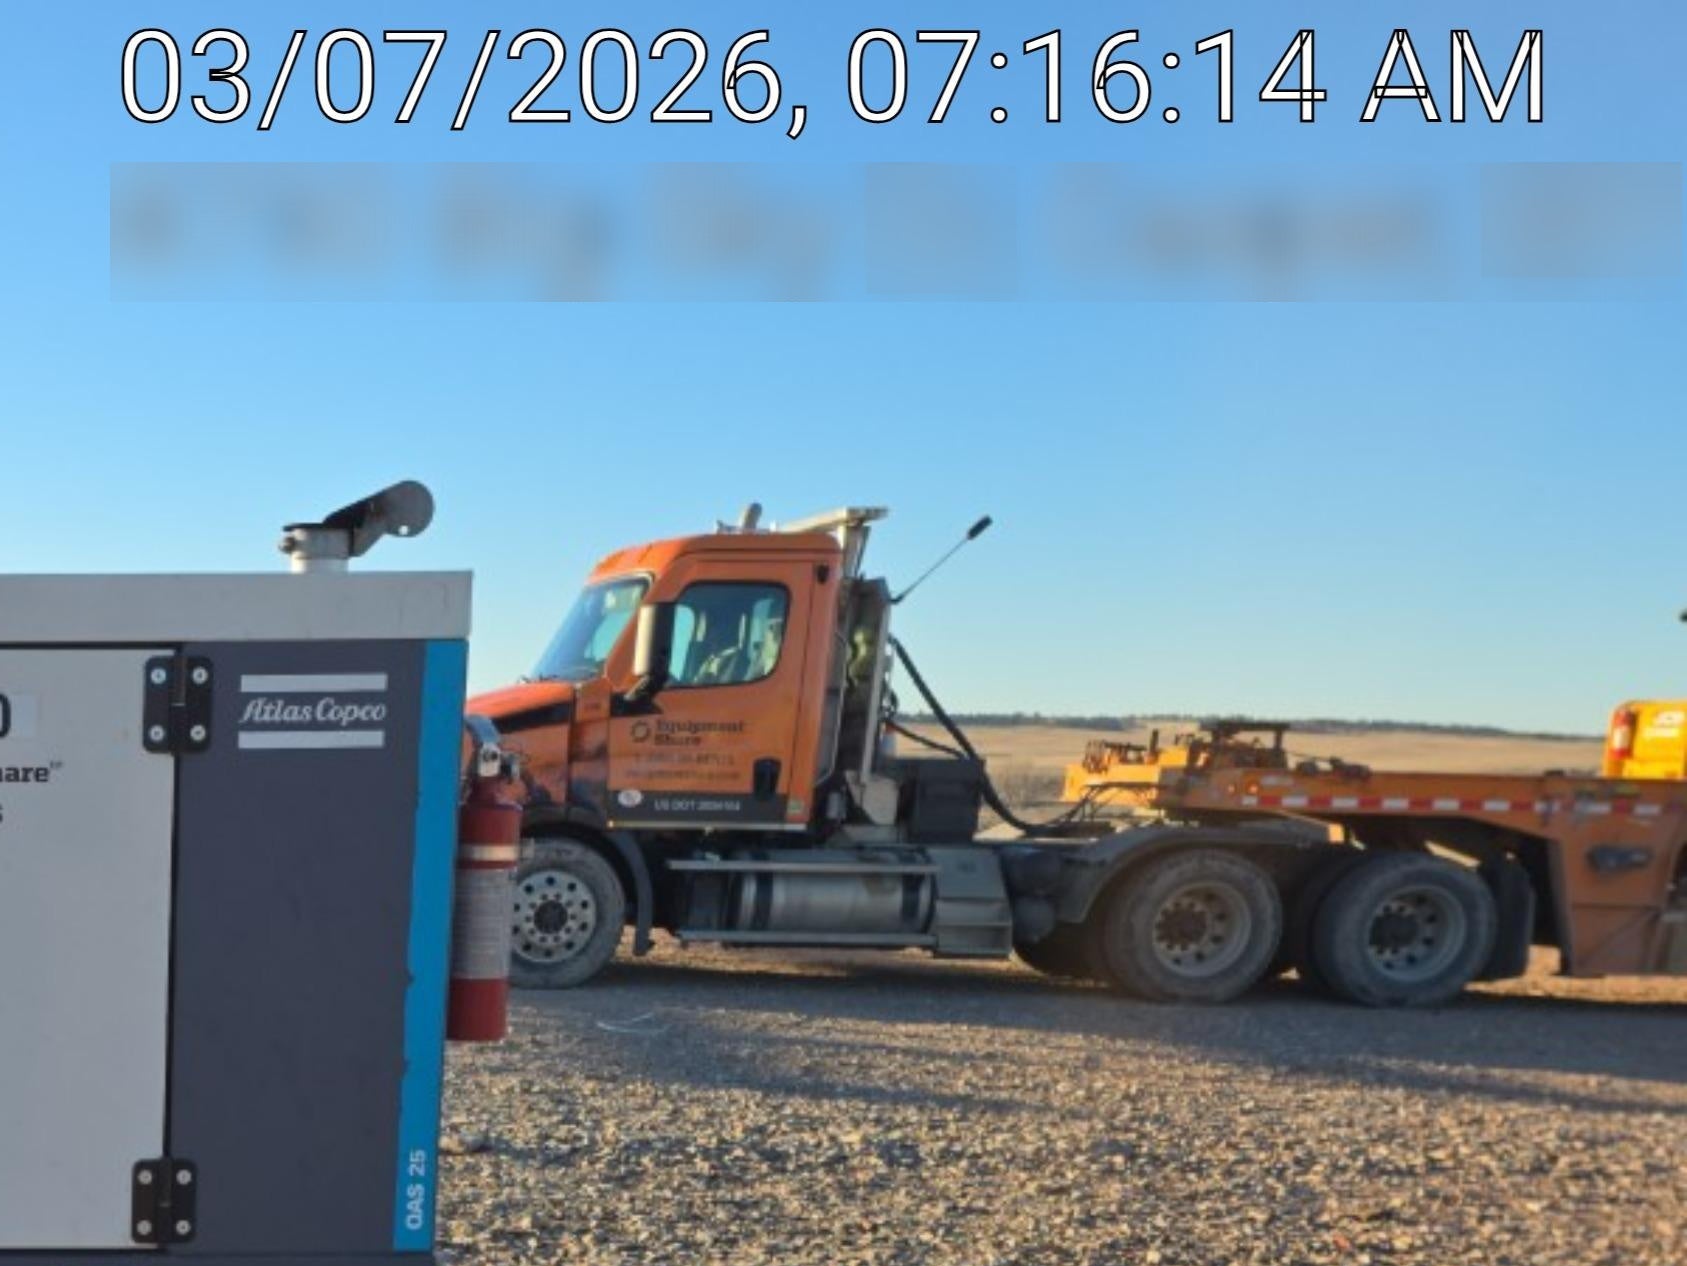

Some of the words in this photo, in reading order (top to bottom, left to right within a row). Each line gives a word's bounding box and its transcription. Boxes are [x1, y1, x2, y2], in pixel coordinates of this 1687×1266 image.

[239, 697, 312, 723] Atlas
[315, 697, 387, 726] Copco
[408, 1149, 426, 1177] 25
